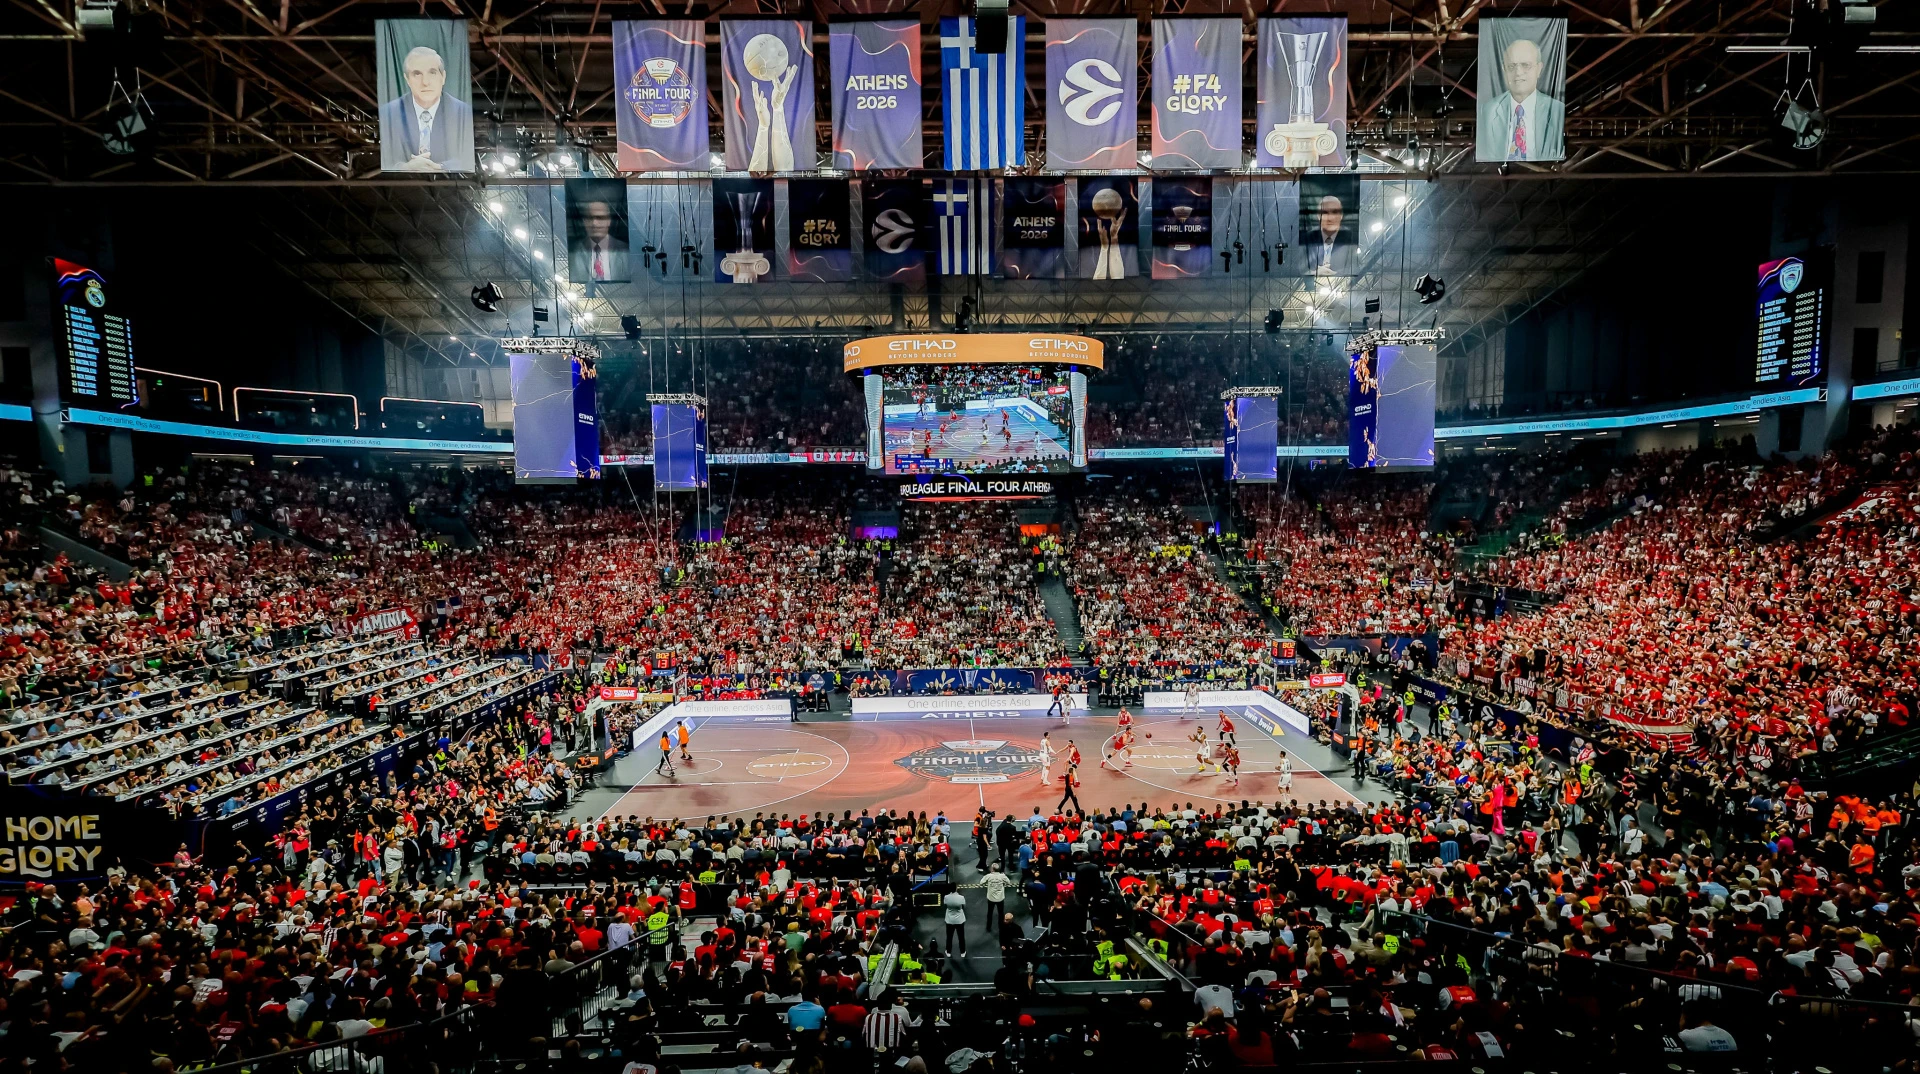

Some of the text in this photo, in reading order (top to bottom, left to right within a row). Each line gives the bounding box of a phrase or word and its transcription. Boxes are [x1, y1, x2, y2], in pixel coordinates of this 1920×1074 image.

[845, 75, 908, 92] ATHENS
[1172, 74, 1221, 94] #F4
[664, 88, 690, 99] FOUR
[856, 95, 897, 110] 2026
[1166, 94, 1228, 114] GLORY
[803, 219, 836, 233] #F4
[1013, 217, 1055, 228] ATHENS
[799, 232, 840, 246] GLORY
[1021, 230, 1048, 240] 2026
[888, 340, 956, 351] ETIHAD
[1029, 339, 1088, 352] ETIHAD
[1884, 384, 1900, 393] One
[1753, 396, 1776, 406] endless
[948, 481, 984, 493] FINAL
[987, 481, 1020, 492] FOUR
[1284, 649, 1293, 657] 13
[658, 660, 668, 668] 13
[908, 698, 1030, 708] One airline, endless Asia
[1154, 696, 1170, 704] One
[1202, 694, 1230, 702] endless
[685, 704, 701, 713] One
[703, 702, 731, 713] airline,
[733, 703, 764, 712] endless
[1244, 709, 1258, 724] bwin
[1258, 718, 1273, 732] bwin
[984, 755, 1041, 763] FOUR
[6, 815, 101, 842] HOME
[0, 846, 102, 878] GLORY
